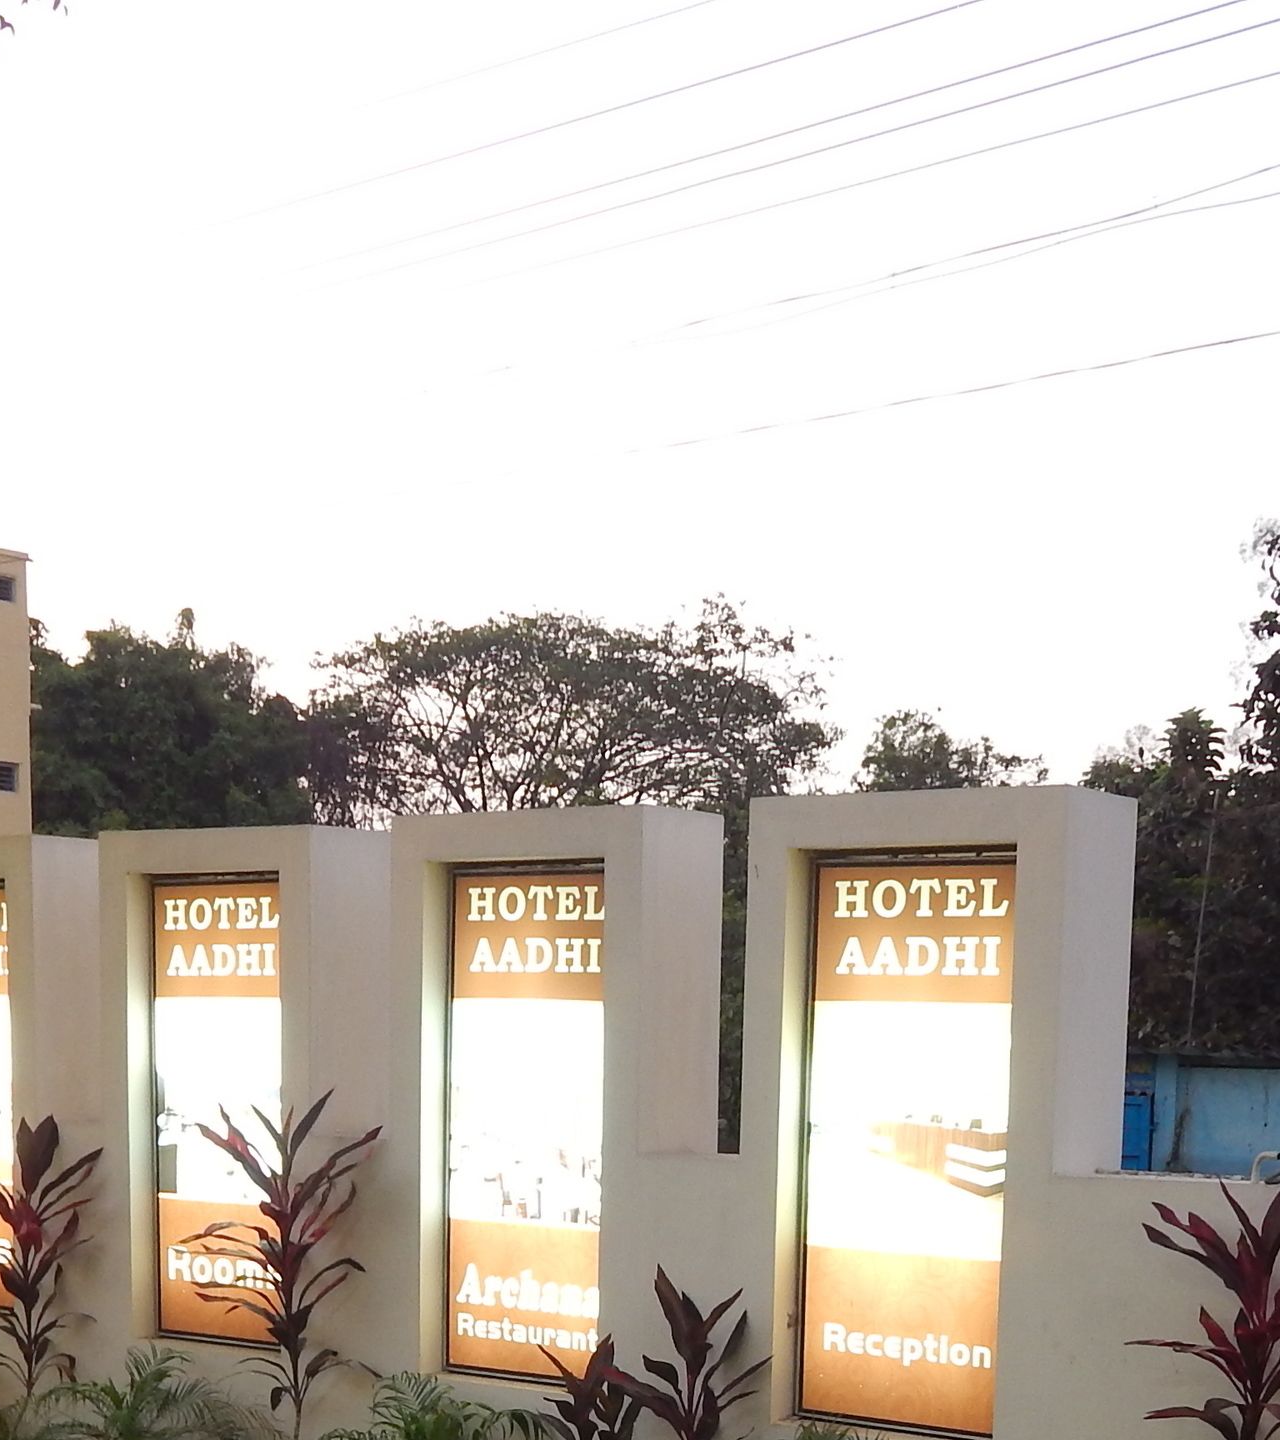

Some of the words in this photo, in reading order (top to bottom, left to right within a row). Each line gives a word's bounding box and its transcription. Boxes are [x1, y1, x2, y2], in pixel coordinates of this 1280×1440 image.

[163, 897, 280, 931] HOTEL
[466, 885, 605, 922] HOTEL
[834, 878, 1010, 919] HOTEL
[166, 943, 276, 977] AADHI
[468, 937, 602, 974] AADHI
[835, 936, 1001, 977] AADHI
[456, 1262, 600, 1319] Archana
[456, 1312, 599, 1353] Restaurant
[823, 1323, 992, 1369] Reception
